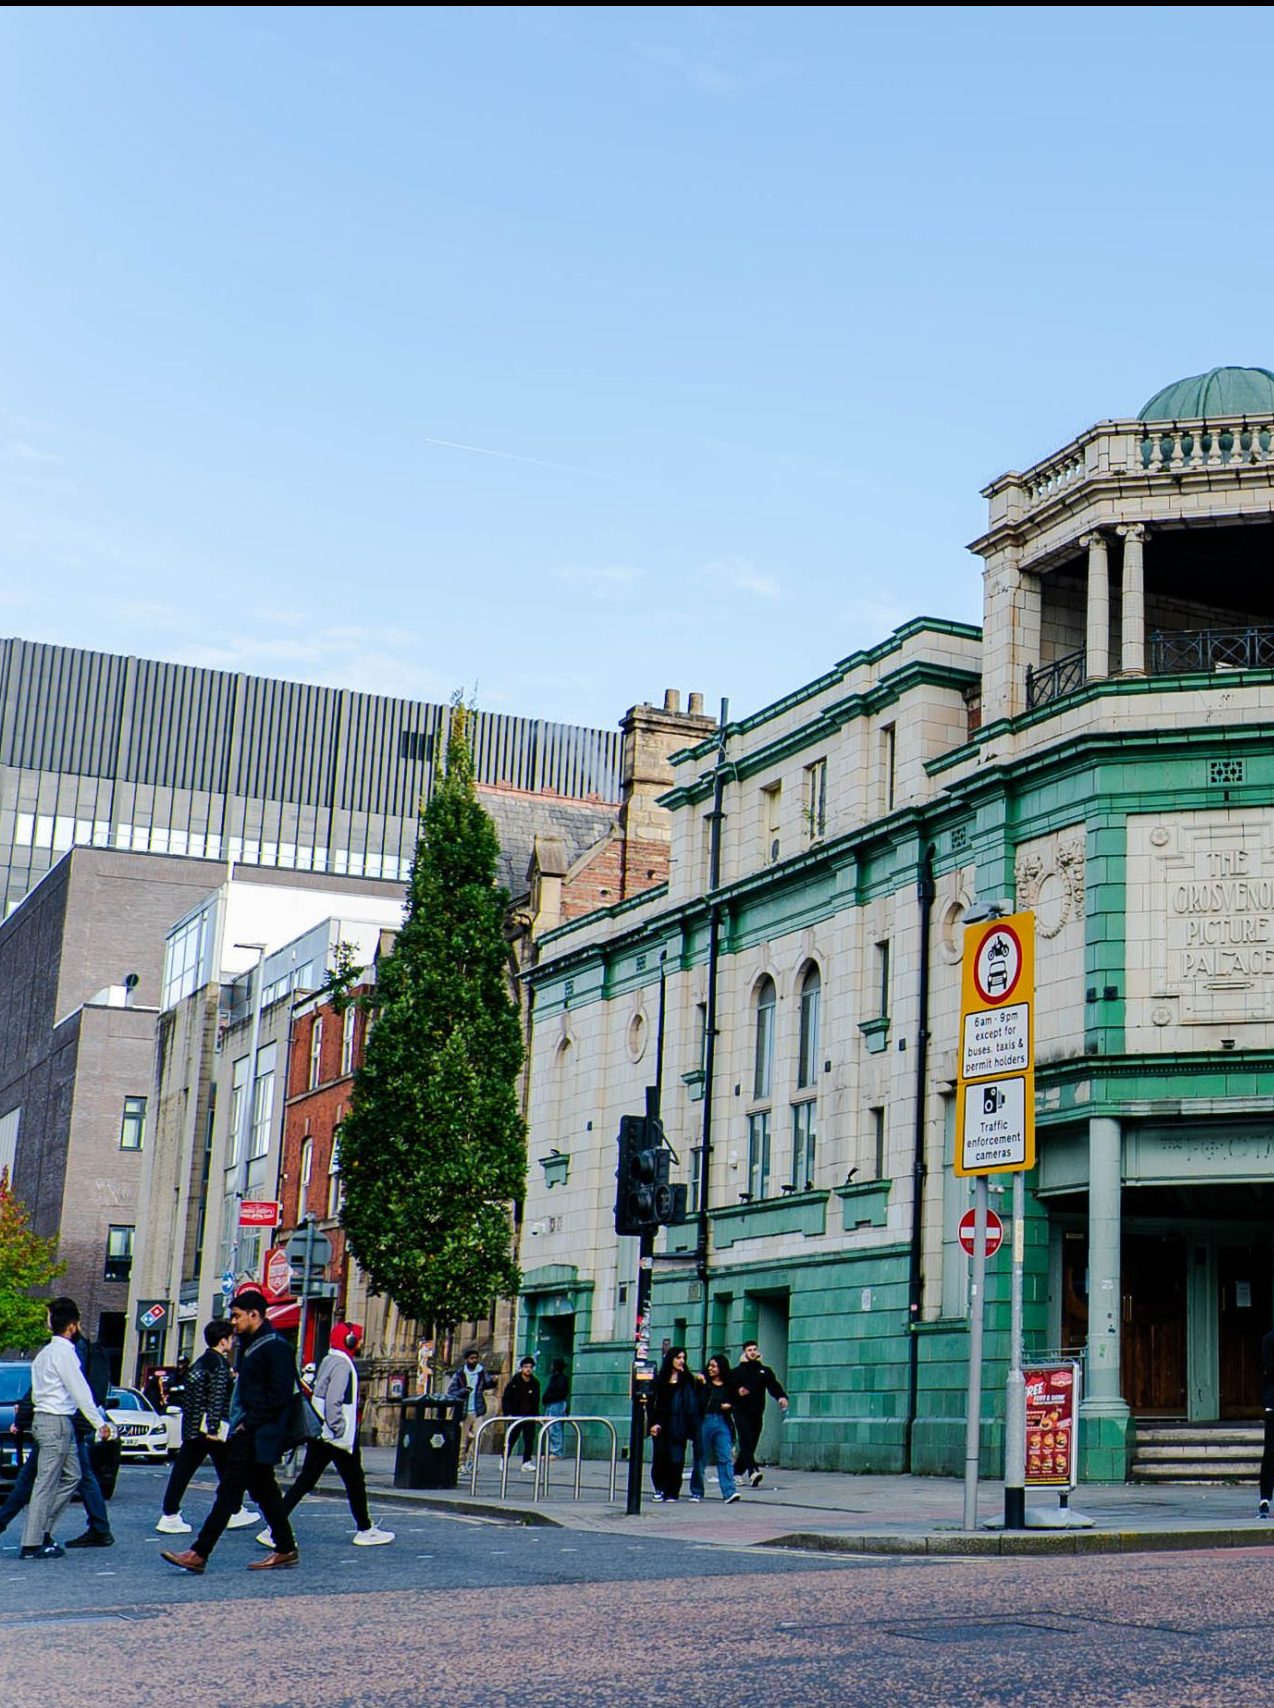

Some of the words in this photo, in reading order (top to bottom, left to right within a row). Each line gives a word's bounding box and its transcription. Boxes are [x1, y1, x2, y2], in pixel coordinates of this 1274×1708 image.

[1207, 851, 1249, 877] THE
[1186, 918, 1270, 946] PICTURE
[974, 1016, 993, 1028] 6am
[1000, 1012, 1019, 1023] 9pm
[976, 1028, 1002, 1041] except
[1004, 1025, 1016, 1036] for
[996, 1040, 1016, 1052] taxis
[1018, 1037, 1024, 1048] &
[966, 1058, 992, 1073] permit
[994, 1055, 1025, 1068] holders
[980, 1120, 1008, 1133] Traffic
[967, 1131, 1021, 1148] enforcement
[975, 1149, 1012, 1161] cameras
